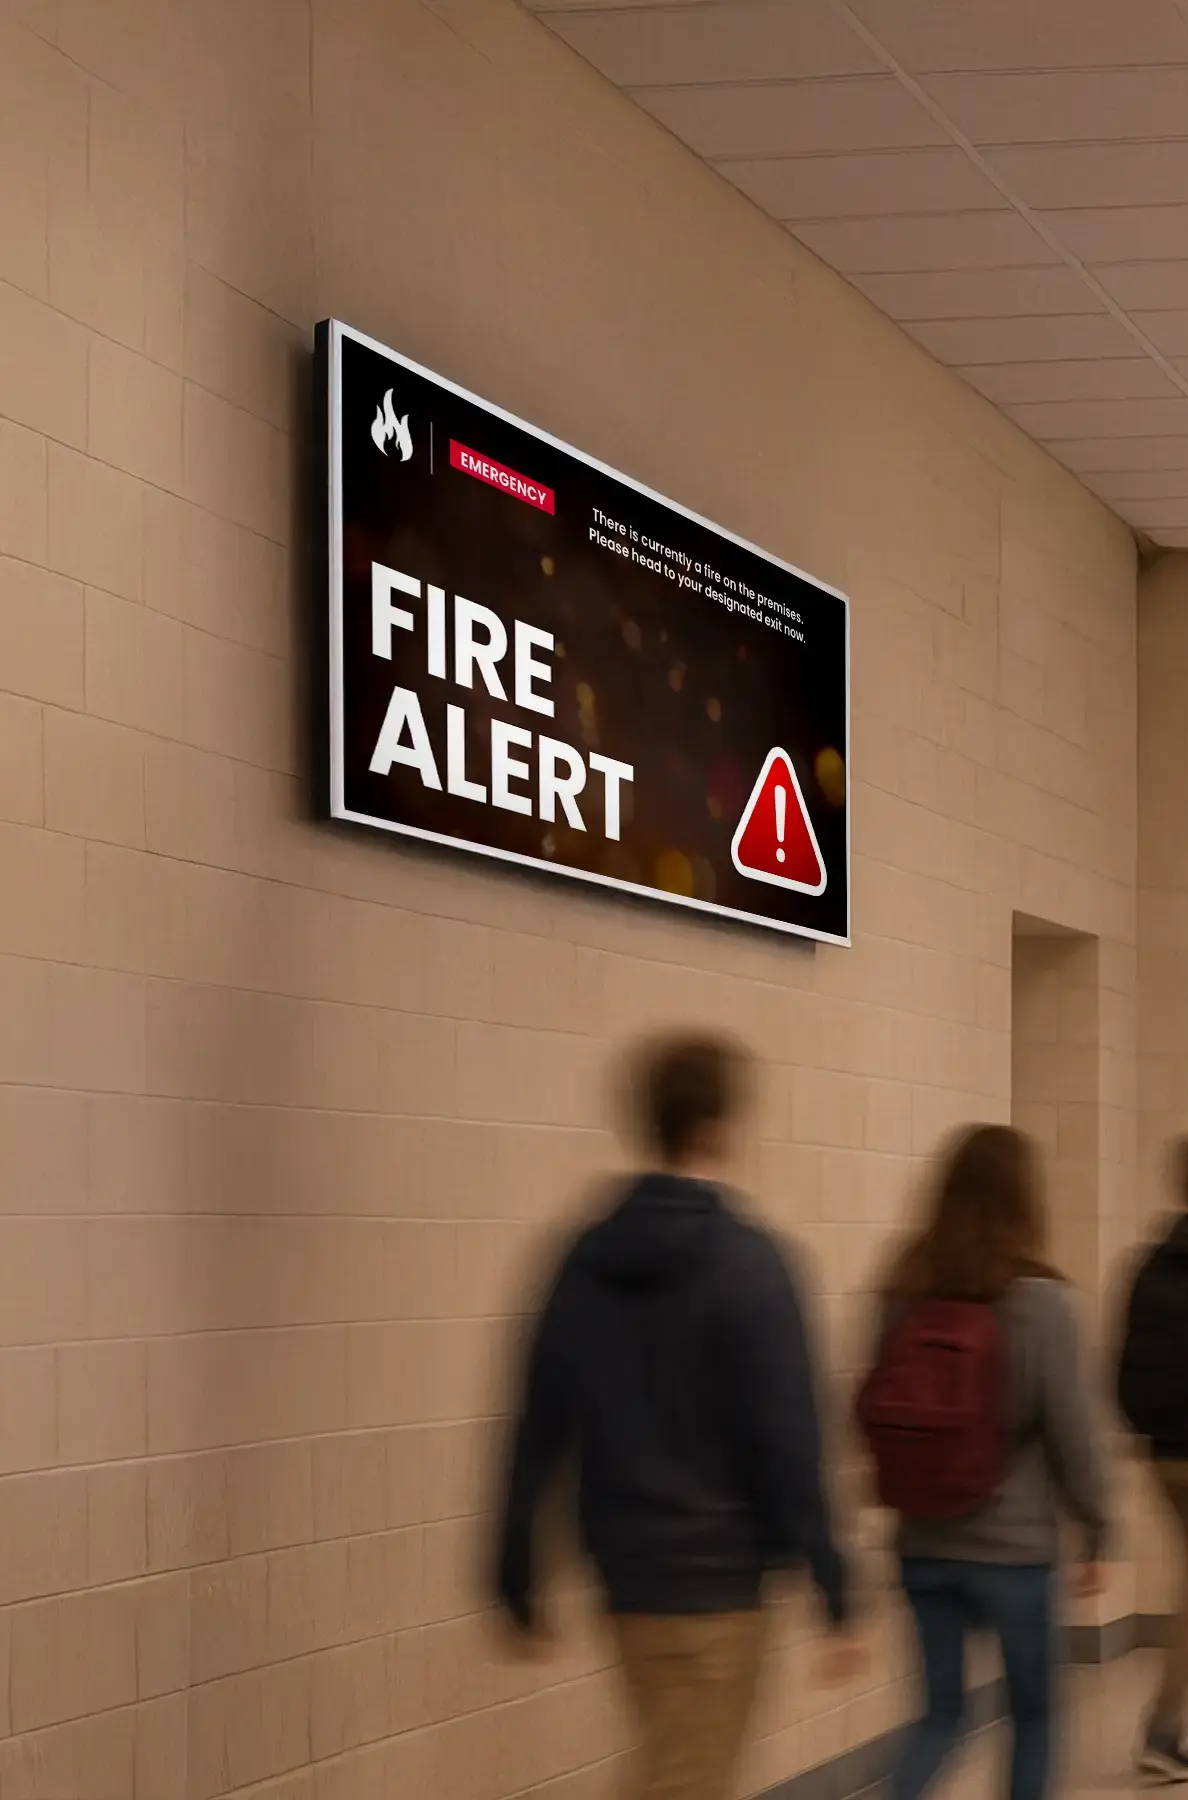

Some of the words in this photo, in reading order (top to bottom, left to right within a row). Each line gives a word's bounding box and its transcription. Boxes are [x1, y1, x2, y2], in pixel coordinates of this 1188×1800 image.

[460, 451, 547, 505] EMERGENCY
[589, 527, 630, 558] Please
[631, 547, 662, 574] head
[664, 564, 676, 580] to
[677, 572, 703, 594] your
[704, 585, 763, 623] designated
[764, 613, 783, 633] exit
[784, 625, 807, 644] now.
[592, 507, 627, 536] There
[629, 525, 639, 542] is
[641, 535, 693, 571] currently
[694, 561, 702, 573] a
[704, 564, 721, 583] fire
[723, 577, 737, 591] on
[739, 581, 756, 600] the
[757, 593, 804, 625] premises.
[371, 561, 555, 718] FIRE
[368, 685, 634, 842] ALERT
